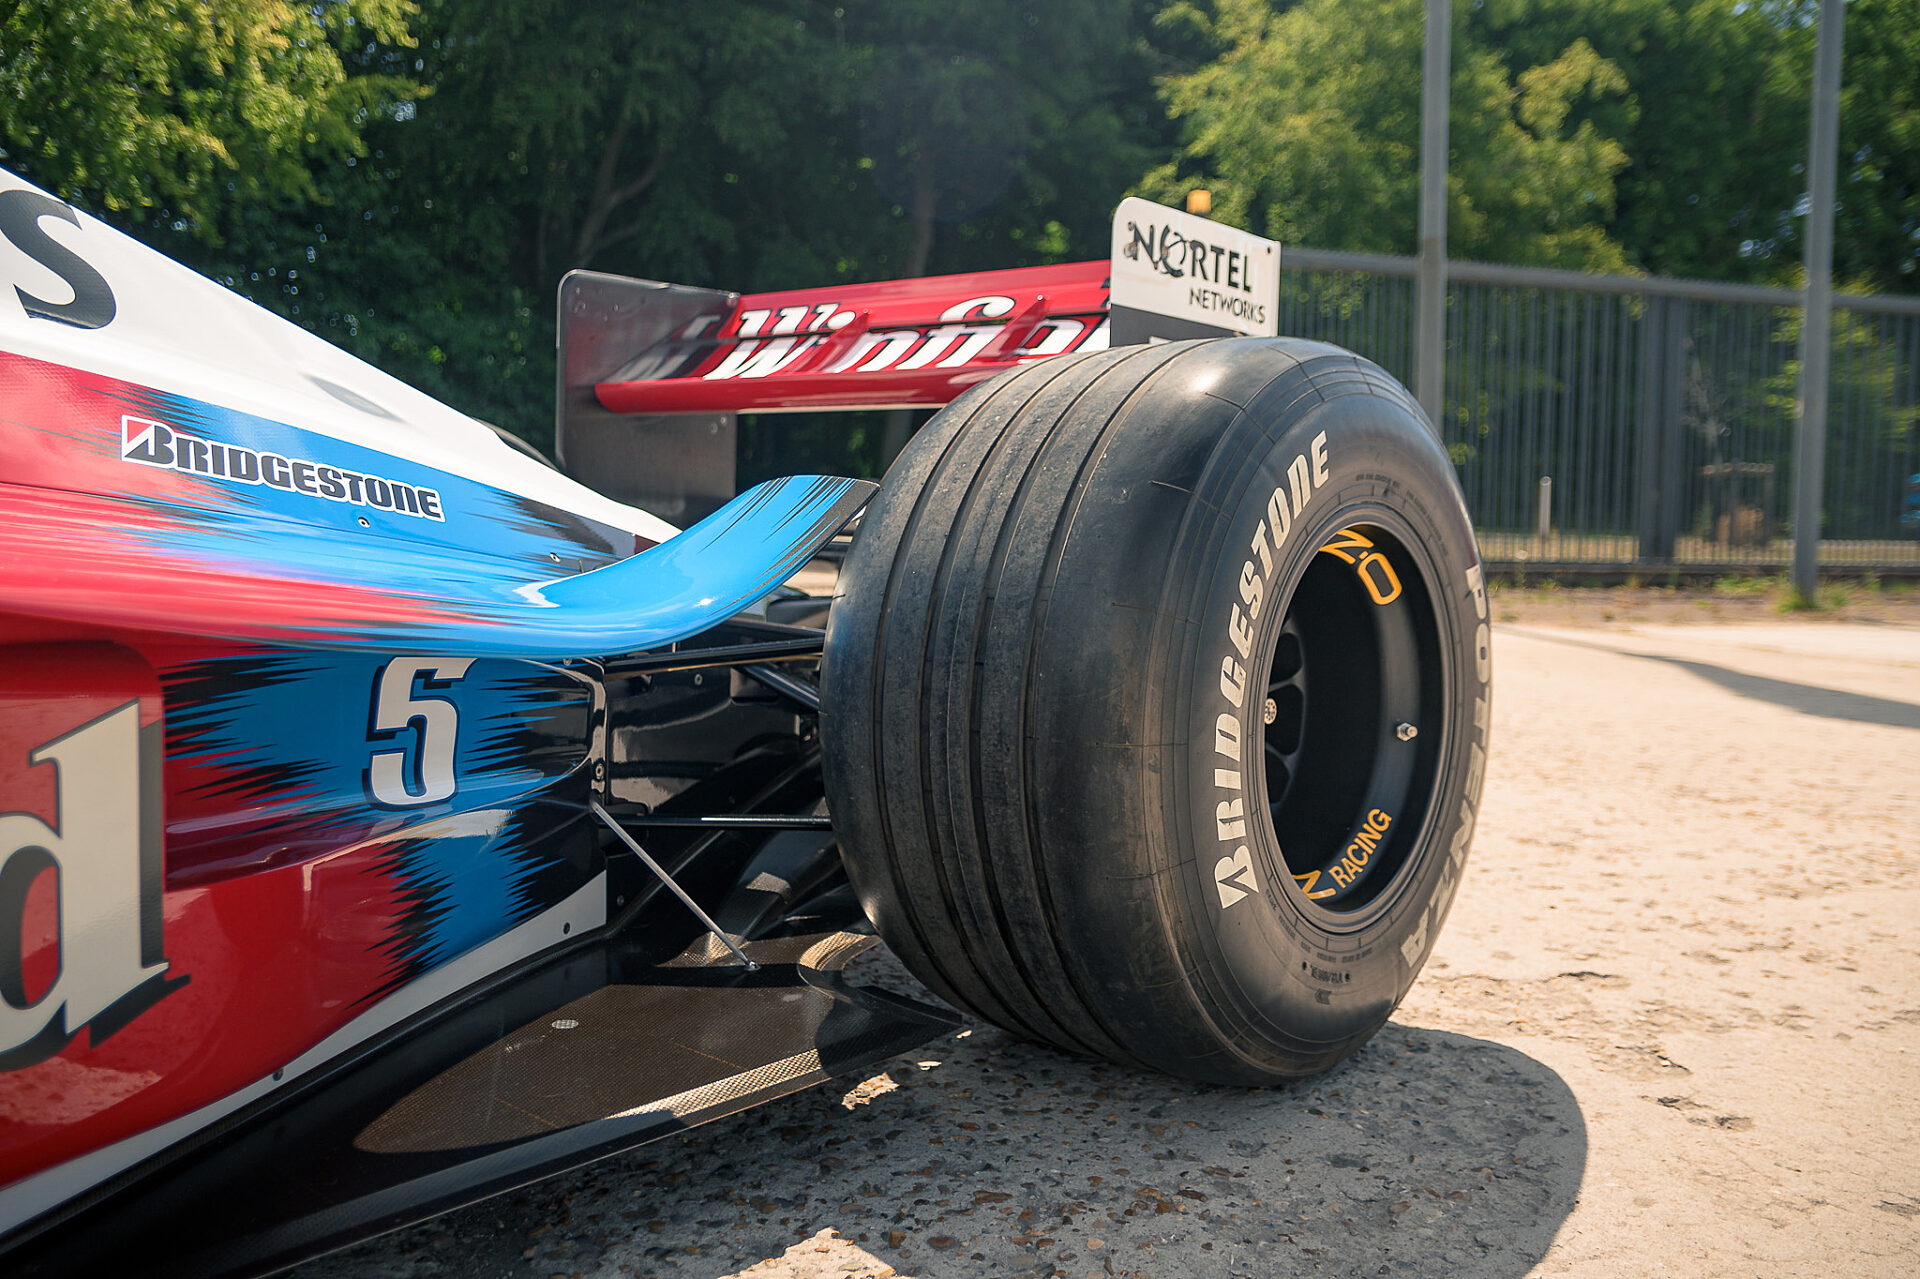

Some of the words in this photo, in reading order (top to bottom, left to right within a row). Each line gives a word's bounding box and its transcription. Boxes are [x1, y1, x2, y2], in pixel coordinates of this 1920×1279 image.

[1124, 220, 1253, 294] NORTEL
[1188, 287, 1266, 324] NETWORKS
[123, 417, 443, 521] BRIDGESTONE
[1214, 429, 1330, 909] BRIDGESTONE
[364, 656, 478, 808] 5
[1400, 564, 1491, 968] POTENZA
[1328, 808, 1393, 889] RACING
